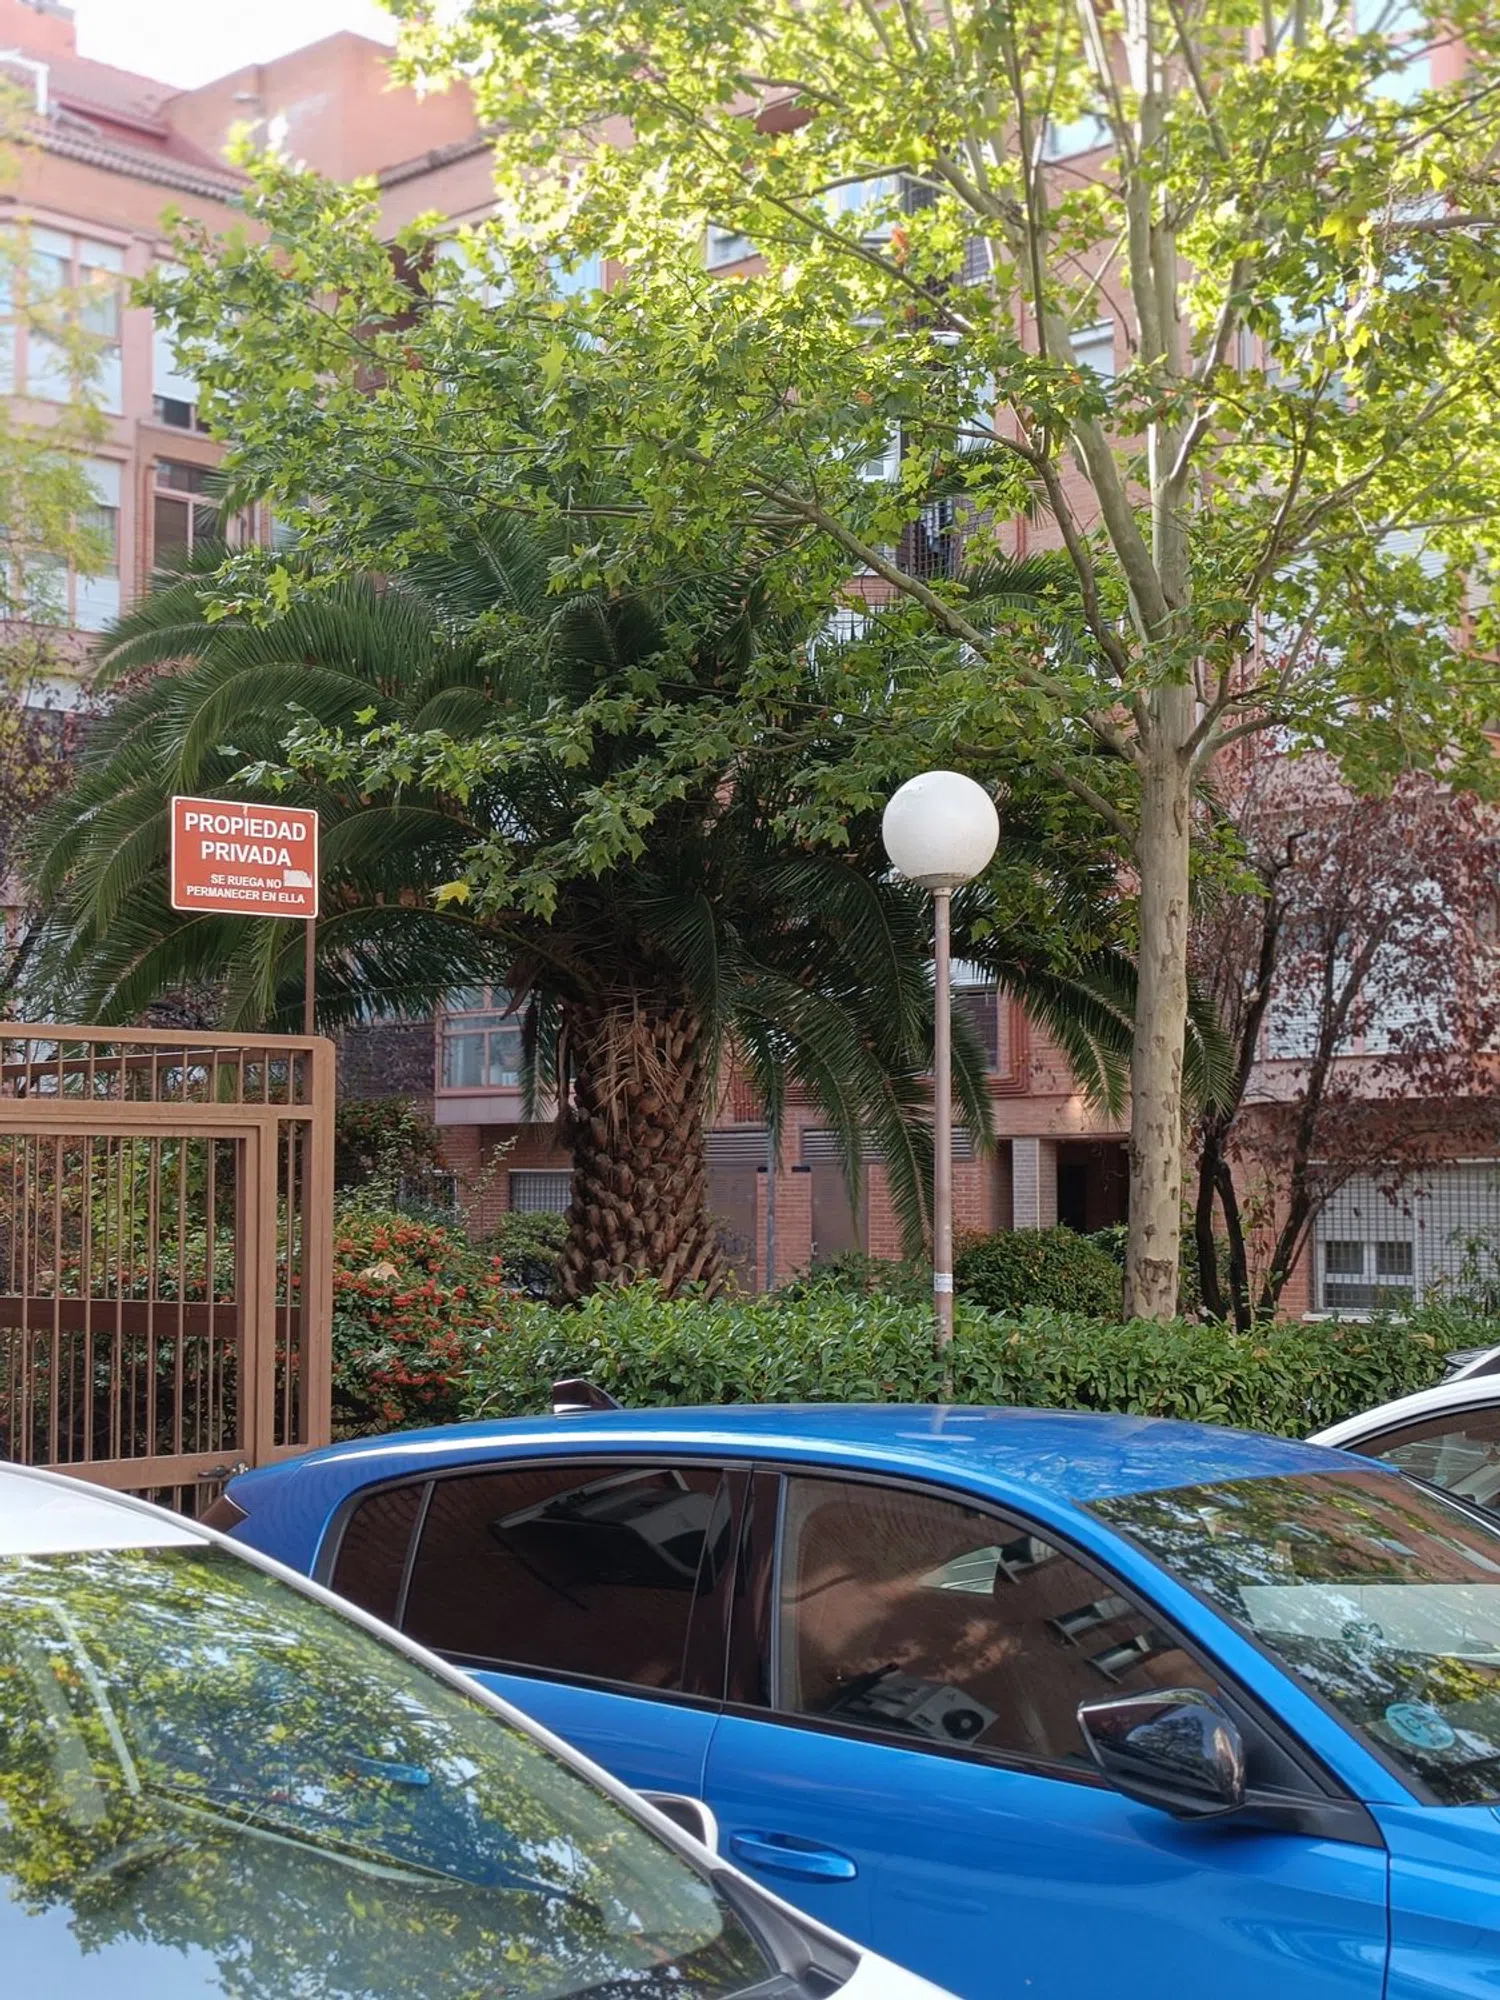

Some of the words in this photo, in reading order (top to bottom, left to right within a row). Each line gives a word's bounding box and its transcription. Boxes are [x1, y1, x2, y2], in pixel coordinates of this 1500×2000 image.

[185, 812, 306, 841] PROPIEDAD
[201, 841, 292, 866] PRIVADA
[211, 874, 226, 885] SE
[227, 875, 264, 888] RUEGA
[266, 878, 282, 889] NO
[186, 885, 260, 901] PERMANECER
[262, 892, 276, 902] EN
[278, 893, 305, 904] ELLA
